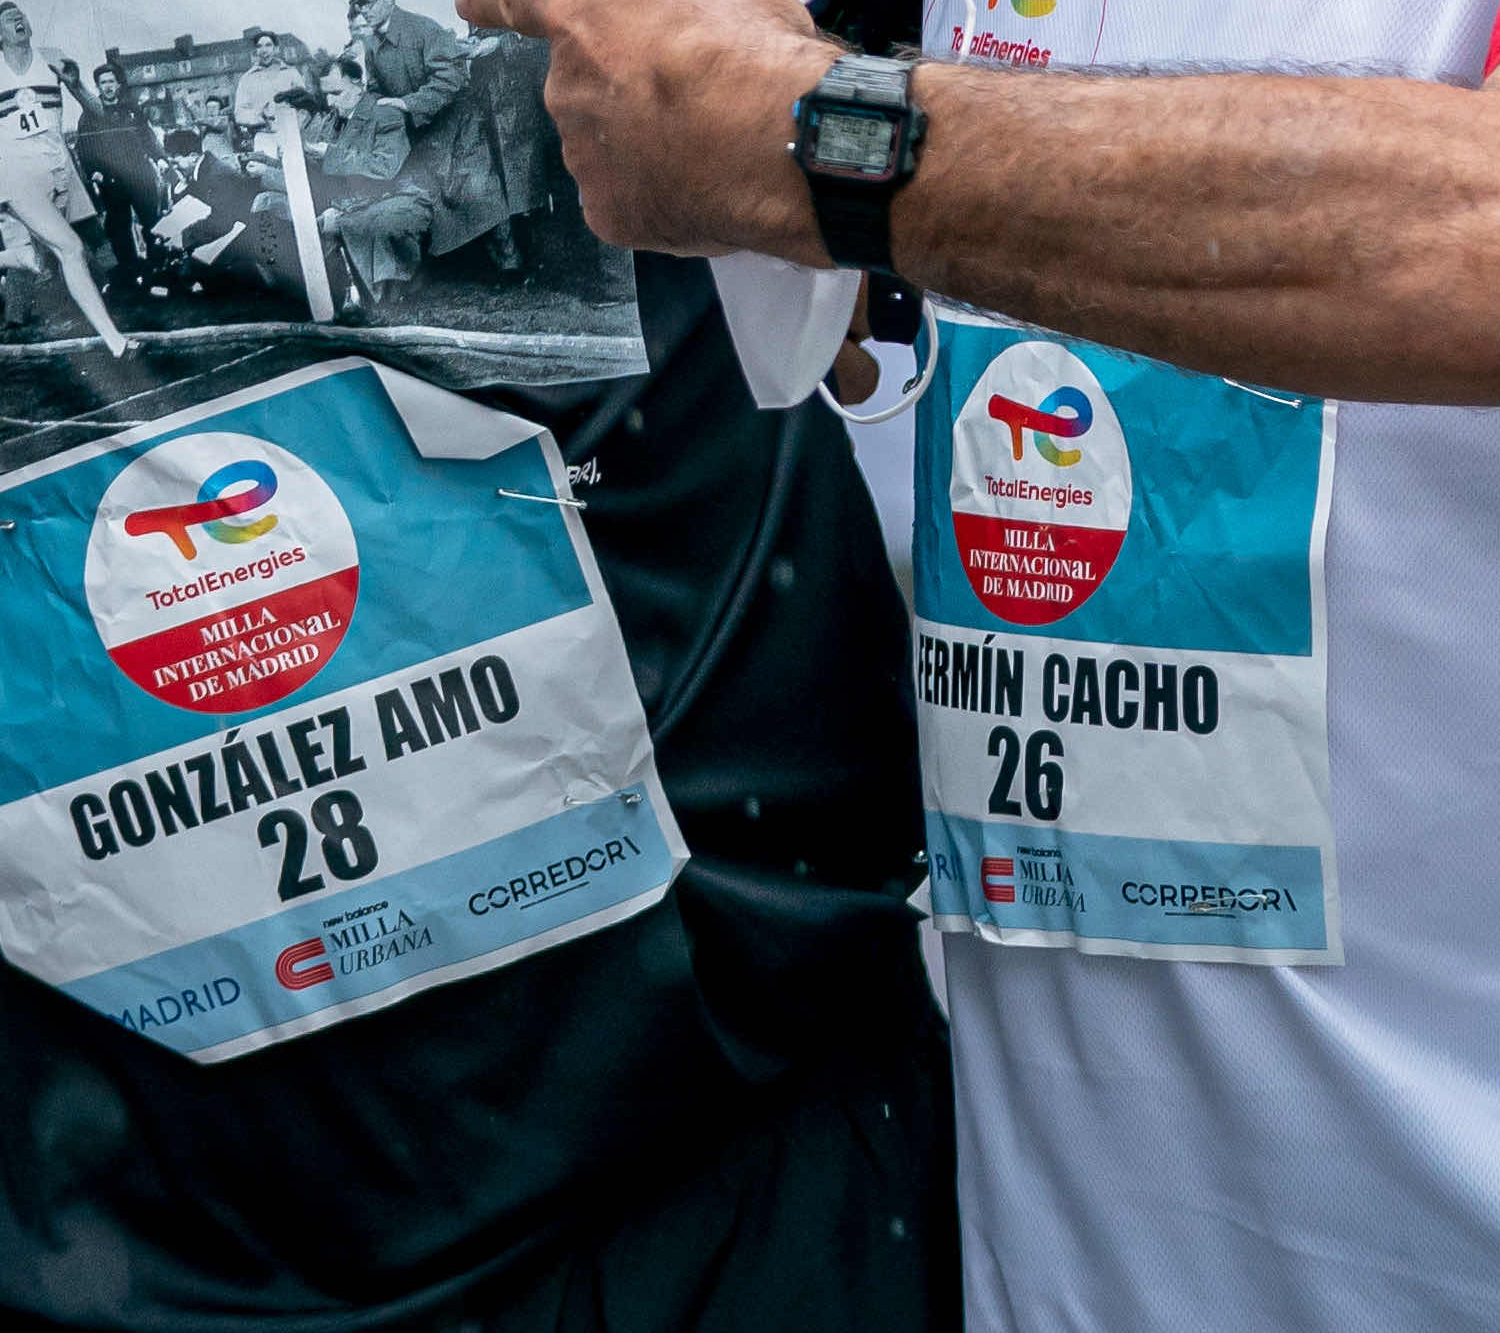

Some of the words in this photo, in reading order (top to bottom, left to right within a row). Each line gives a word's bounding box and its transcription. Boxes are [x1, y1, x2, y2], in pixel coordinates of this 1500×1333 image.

[951, 26, 1052, 68] ToalEnergies
[20, 110, 39, 132] 41
[984, 475, 1093, 508] TotalEnergies
[1004, 528, 1056, 552] MILLA
[146, 546, 306, 611] TotalEnergies
[983, 575, 1003, 596] DE
[1006, 579, 1073, 603] MADRID
[200, 606, 278, 647] MILLA
[188, 676, 224, 703] DE
[225, 643, 319, 691] MADRID
[1042, 652, 1219, 736] CACHO
[69, 706, 367, 861] GONZÁLEZ
[374, 654, 521, 762] AMO
[987, 725, 1065, 821] 26
[256, 789, 379, 903] 28
[322, 916, 344, 928] new
[344, 901, 389, 921] balance
[330, 909, 416, 952] MILLA
[340, 927, 433, 975] URBANA
